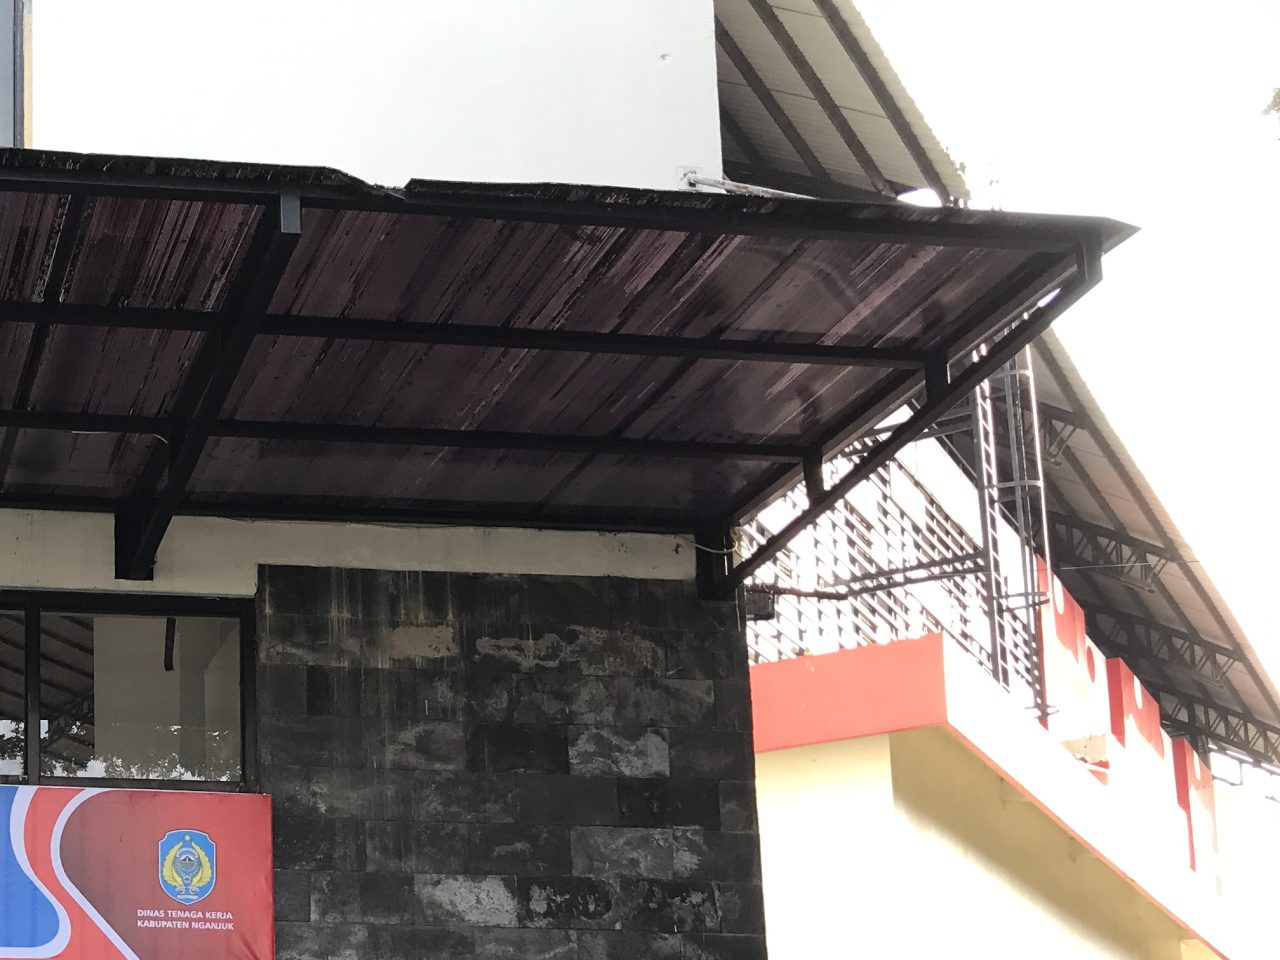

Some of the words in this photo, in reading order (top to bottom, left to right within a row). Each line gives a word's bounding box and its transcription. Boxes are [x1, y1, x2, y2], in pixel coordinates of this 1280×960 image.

[137, 909, 165, 918] DINAS
[167, 910, 204, 919] TENAGA
[205, 911, 233, 920] KERJA
[137, 920, 189, 929] KABUPATEN
[191, 922, 234, 930] NGANJUK
